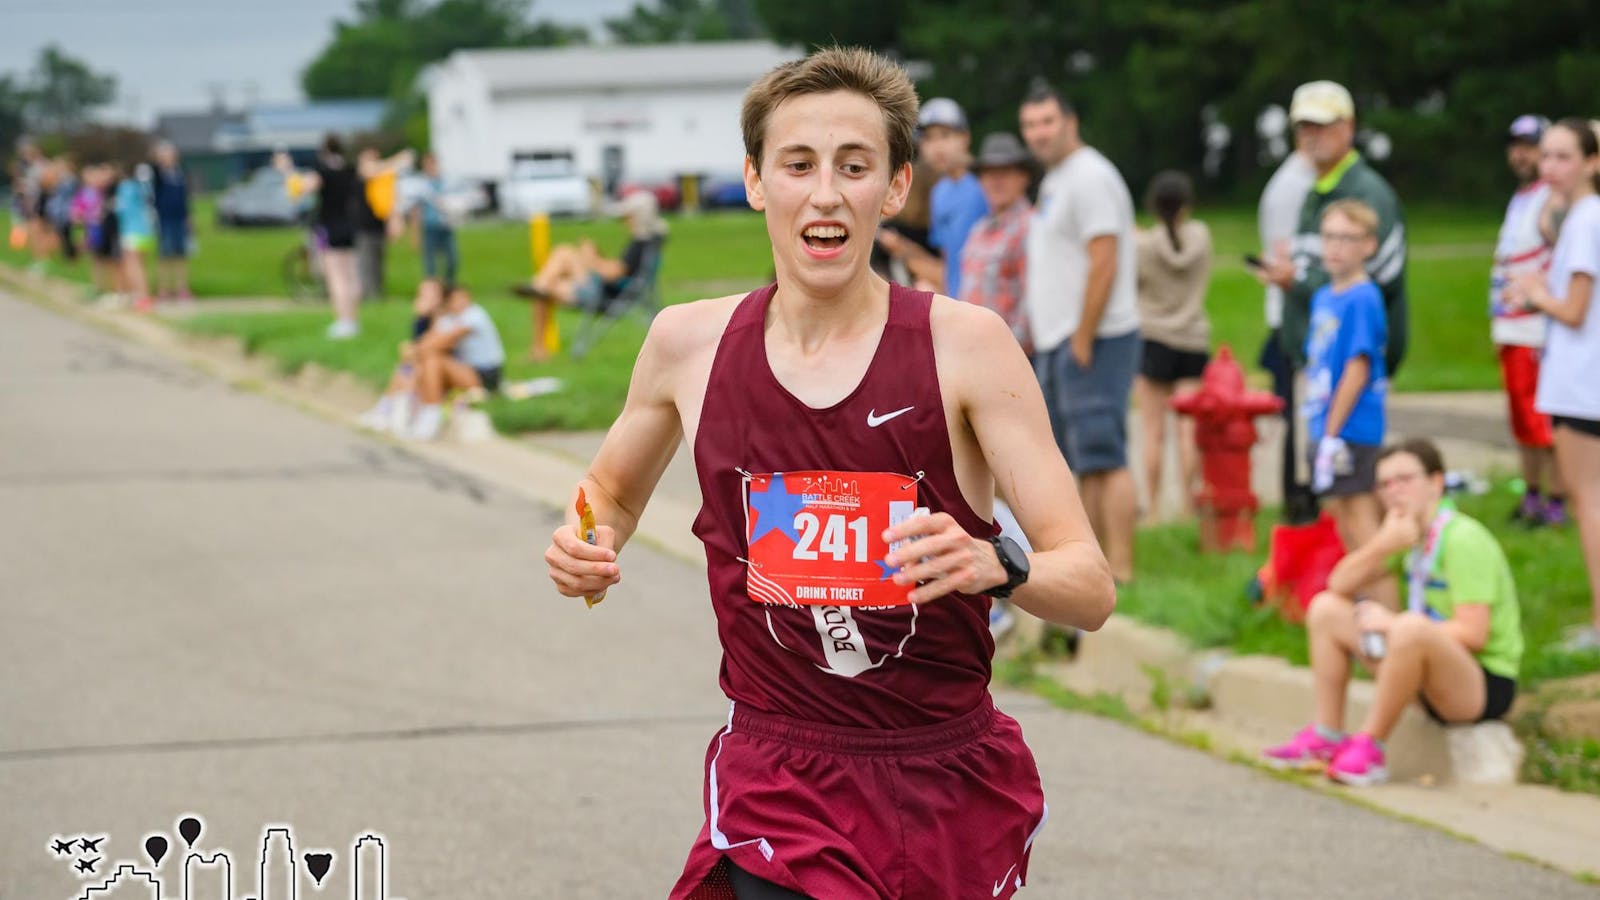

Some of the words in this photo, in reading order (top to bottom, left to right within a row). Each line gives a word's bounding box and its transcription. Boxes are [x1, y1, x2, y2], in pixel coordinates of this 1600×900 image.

[802, 493, 832, 501] BATTLE
[834, 495, 860, 503] CREEK
[792, 512, 868, 563] 241
[796, 586, 828, 600] DRINK
[829, 587, 865, 601] TICKET
